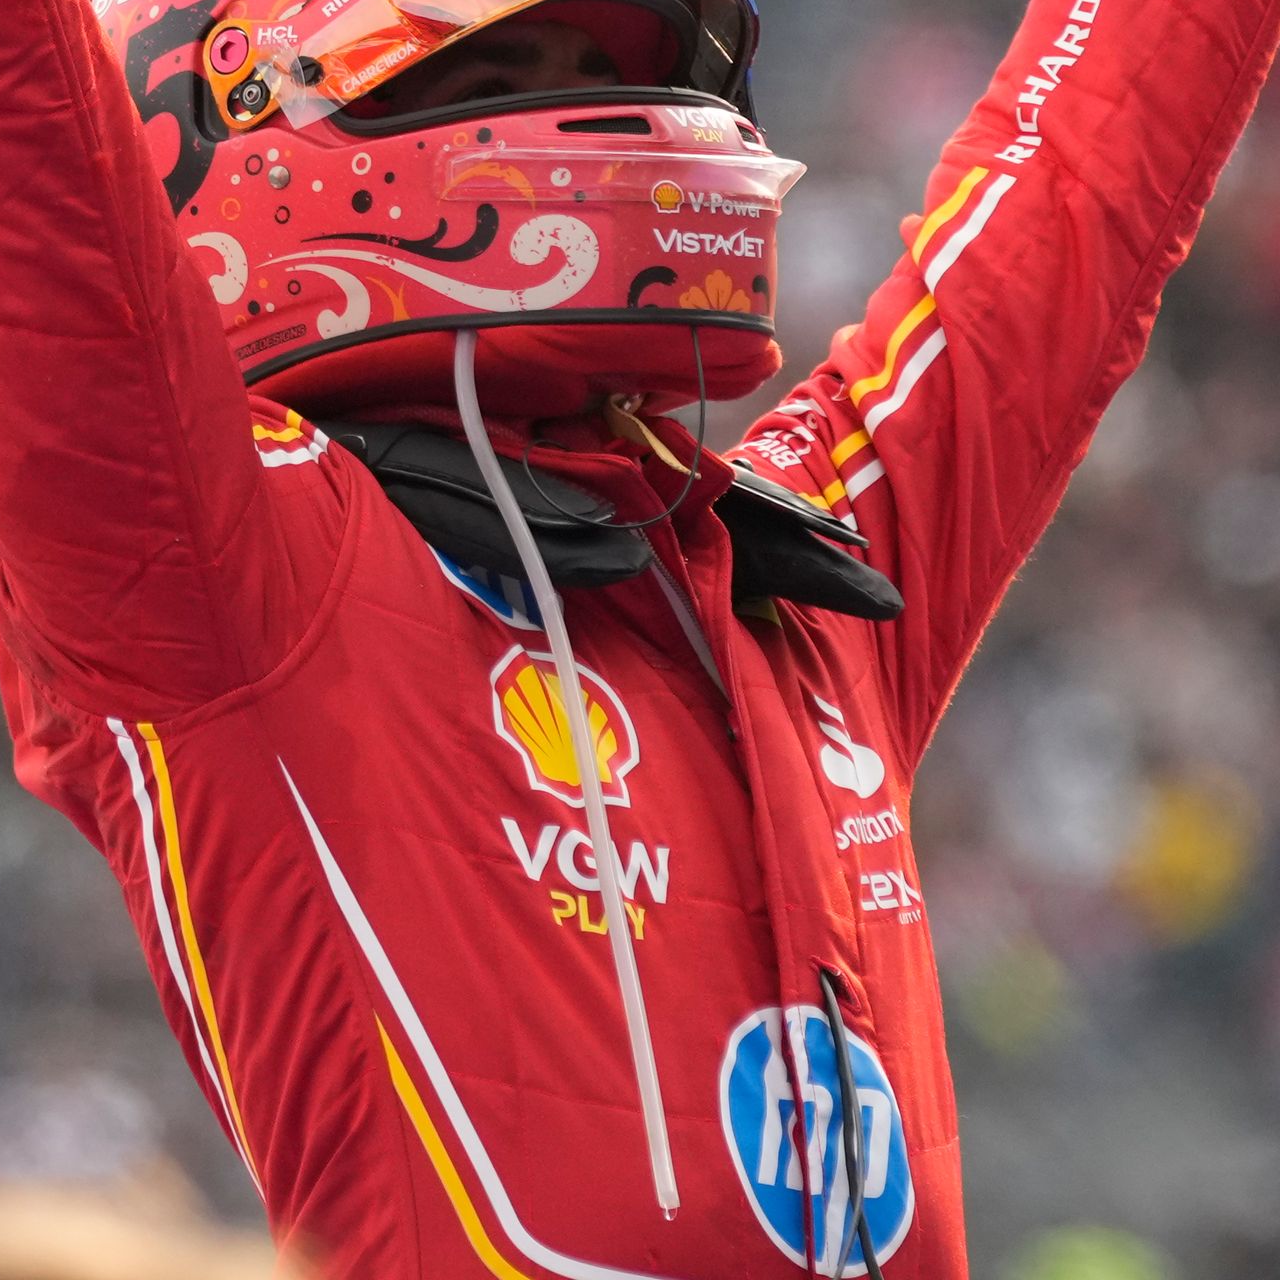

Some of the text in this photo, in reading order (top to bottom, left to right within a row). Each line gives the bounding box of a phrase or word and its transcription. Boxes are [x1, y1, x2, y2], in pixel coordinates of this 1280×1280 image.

[257, 25, 298, 43] HCL
[666, 106, 731, 131] VGW
[692, 128, 725, 143] PLAY
[688, 191, 761, 219] V-Power
[500, 816, 670, 904] VGW
[550, 890, 646, 940] PLY
